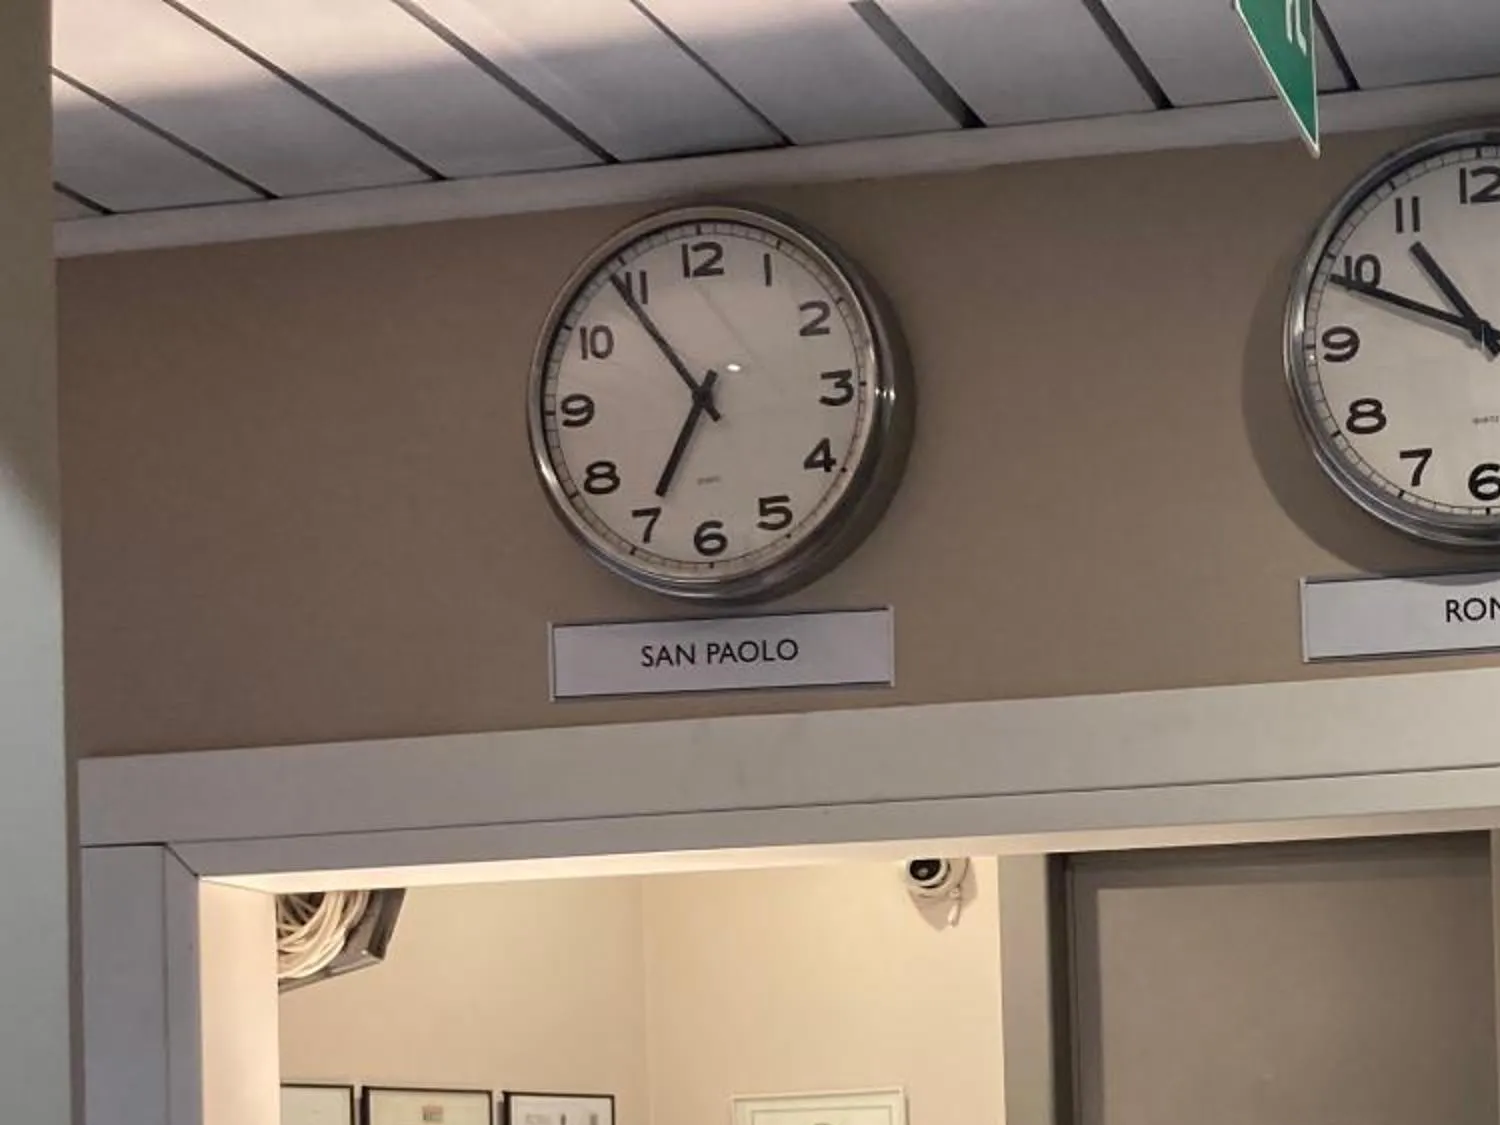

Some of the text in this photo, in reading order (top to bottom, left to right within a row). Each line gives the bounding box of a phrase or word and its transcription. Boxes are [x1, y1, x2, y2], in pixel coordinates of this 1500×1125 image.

[1394, 197, 1421, 234] 11
[681, 241, 724, 278] 12
[763, 253, 772, 286] 1
[1344, 254, 1382, 290] 10
[624, 271, 649, 304] 11
[799, 301, 831, 336] 2
[579, 326, 615, 360] 10
[1321, 326, 1360, 362] 9
[820, 370, 854, 407] 3
[561, 394, 595, 427] 9
[1346, 398, 1387, 435] 8
[804, 438, 838, 472] 4
[1400, 449, 1434, 487] 7
[584, 461, 621, 495] 8
[632, 507, 661, 543] 7
[758, 496, 793, 531] 5
[693, 521, 728, 556] 6
[641, 639, 799, 667] SAN PAOLO
